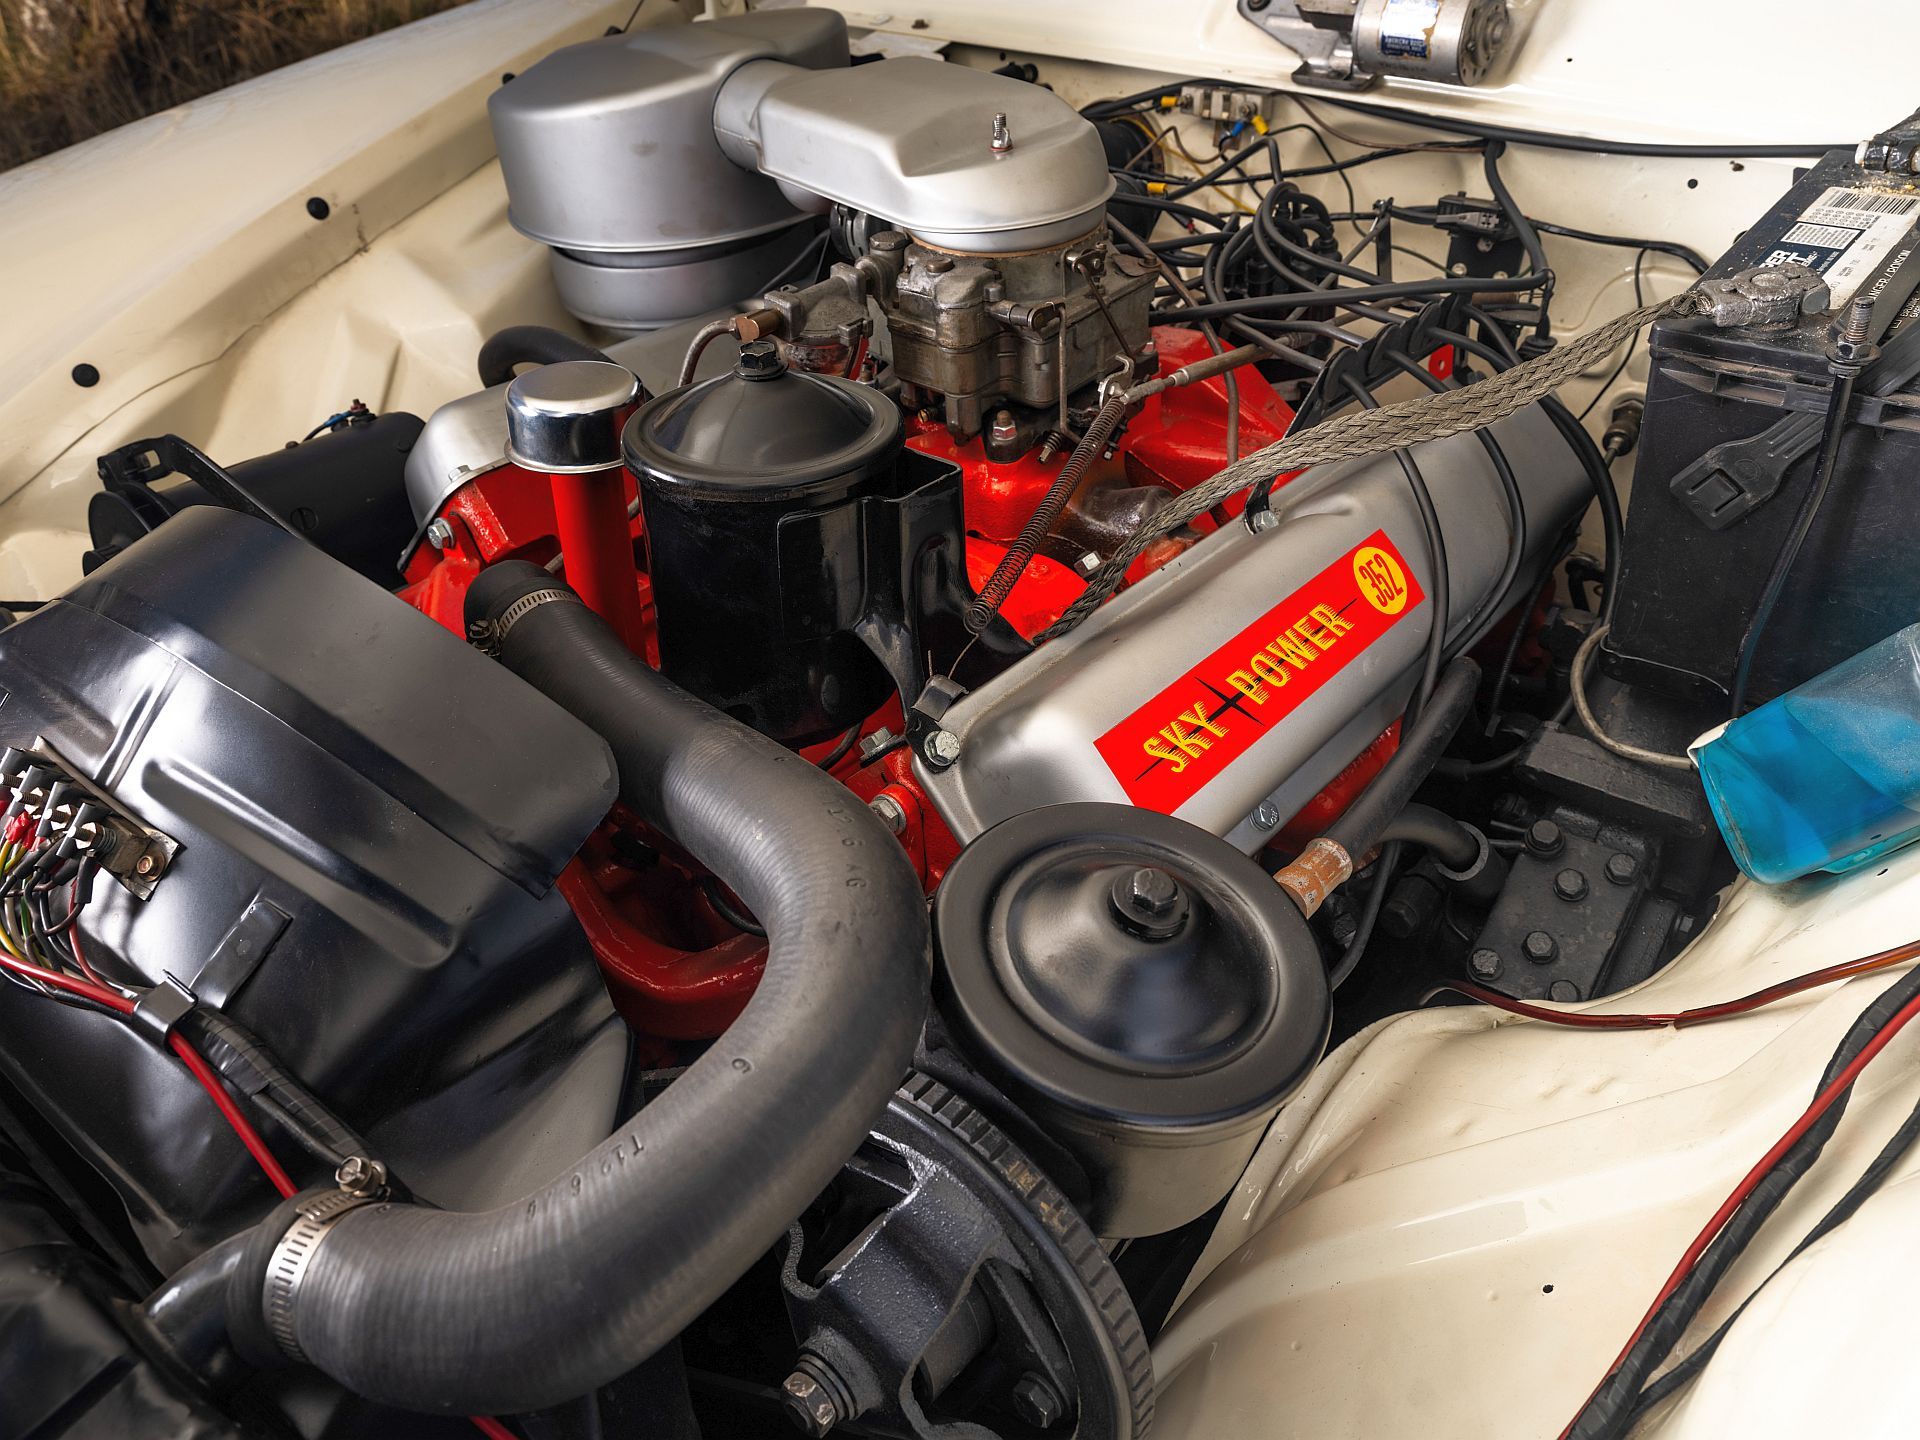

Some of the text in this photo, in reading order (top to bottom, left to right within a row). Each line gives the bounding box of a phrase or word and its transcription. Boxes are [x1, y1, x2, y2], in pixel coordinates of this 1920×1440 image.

[1868, 278, 1889, 300] NGER
[1143, 552, 1404, 773] SKY POWER 352
